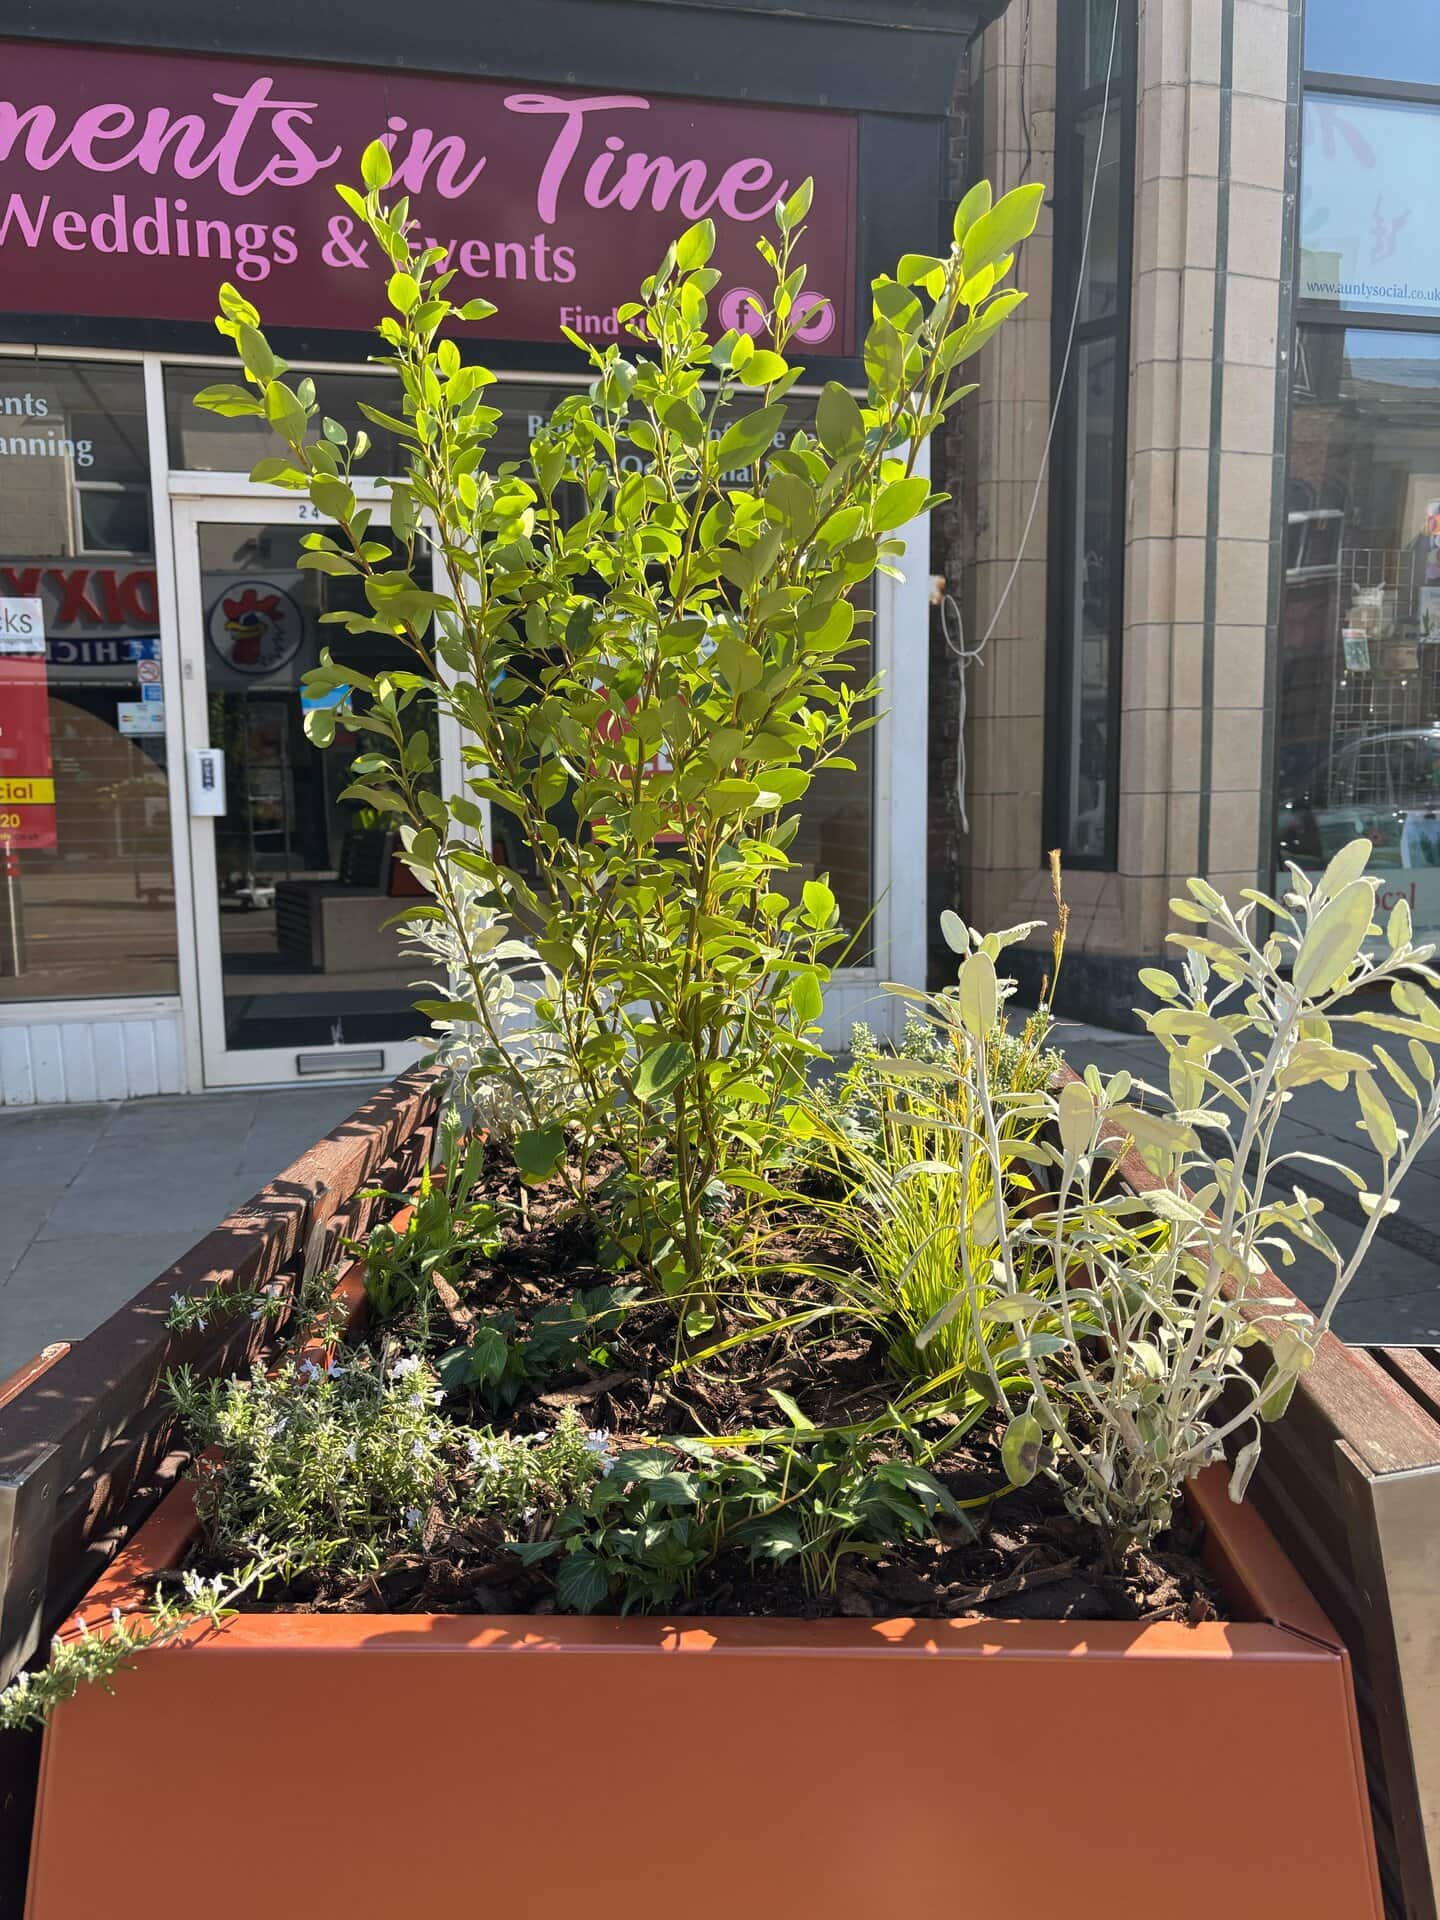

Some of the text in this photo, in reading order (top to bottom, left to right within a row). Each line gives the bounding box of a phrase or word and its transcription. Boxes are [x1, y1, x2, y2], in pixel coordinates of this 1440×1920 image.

[503, 93, 789, 224] Time
[0, 192, 299, 282] Weddings
[321, 214, 370, 269] &
[1306, 281, 1440, 301] www.auntysocial.co.uk
[560, 306, 619, 335] Find
[0, 392, 48, 417] nts
[0, 607, 33, 634] ks
